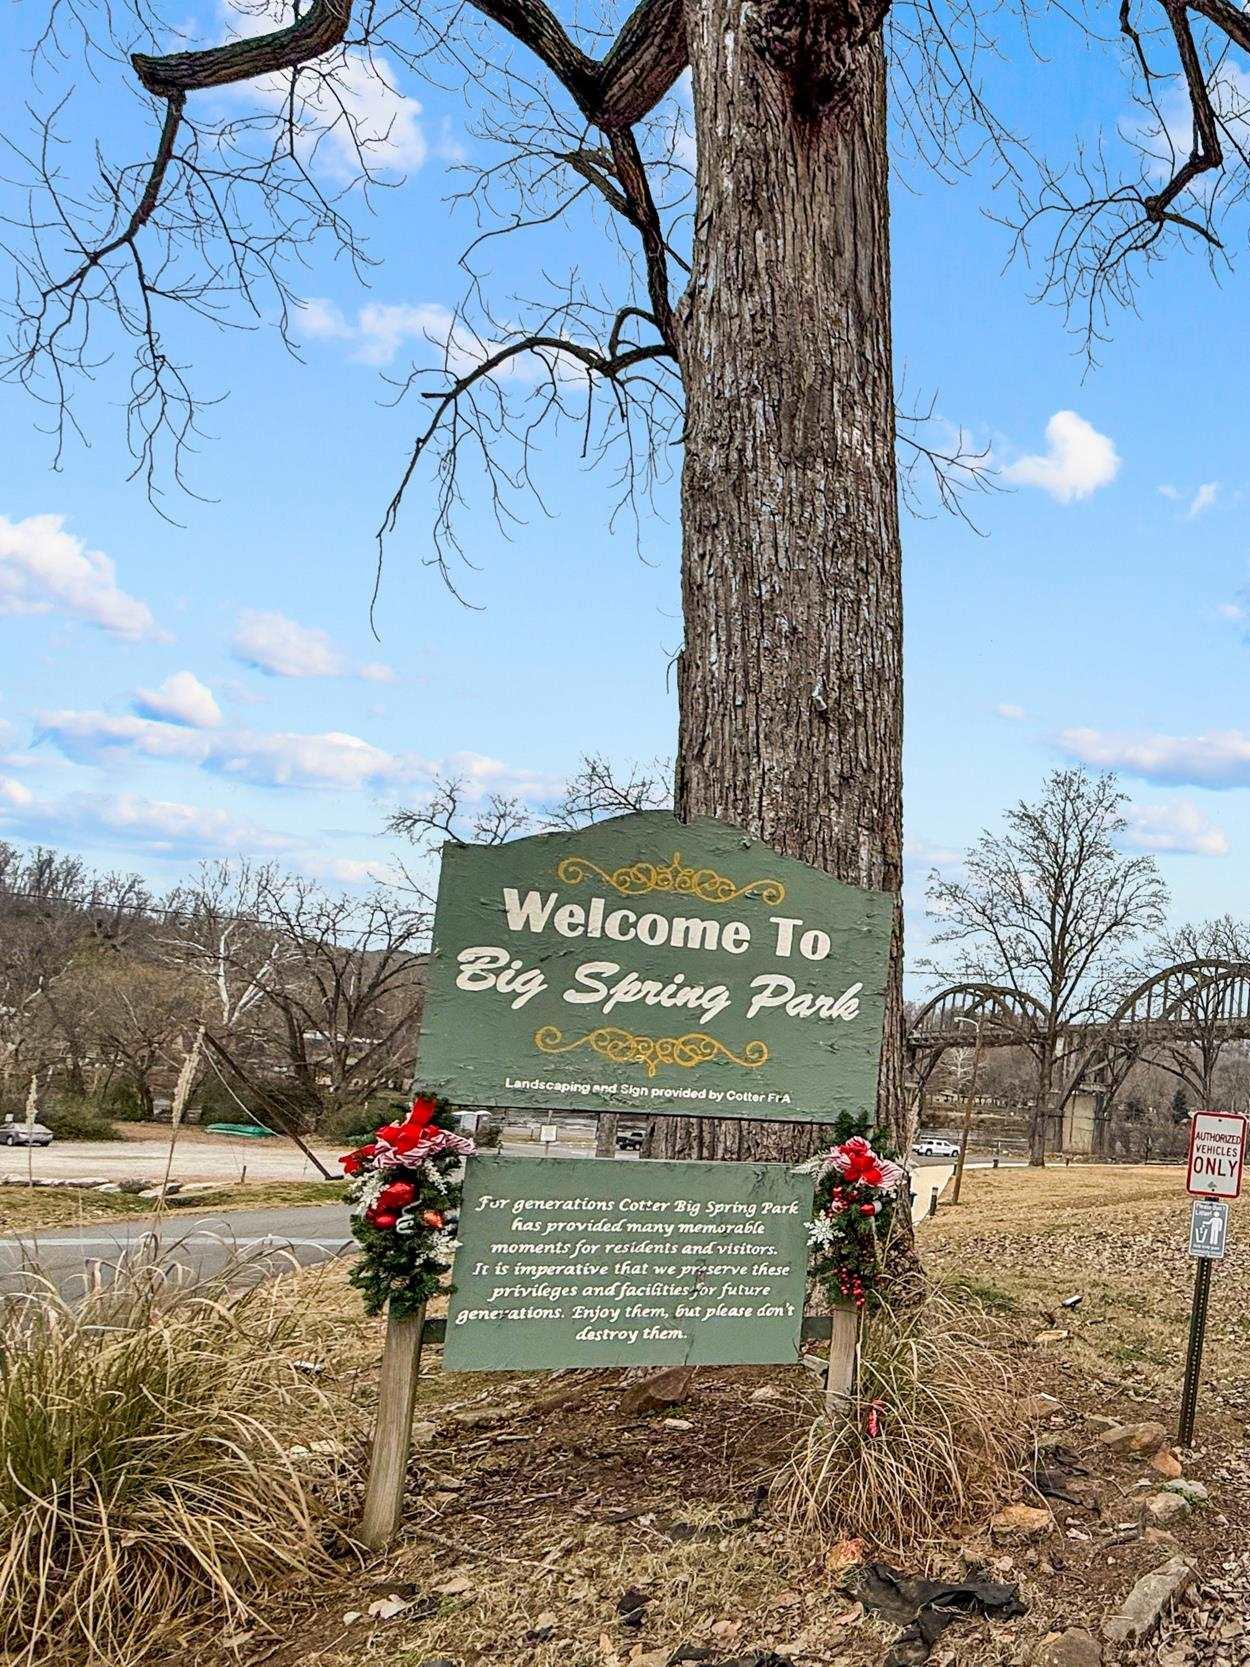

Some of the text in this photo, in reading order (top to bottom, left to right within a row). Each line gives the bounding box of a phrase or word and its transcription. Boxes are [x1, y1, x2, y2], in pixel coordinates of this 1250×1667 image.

[503, 887, 831, 961] Welcome To
[455, 946, 863, 1024] Big Spring Park
[505, 1077, 591, 1095] Landscaping
[592, 1083, 618, 1094] and
[620, 1084, 649, 1097] Sign
[651, 1087, 707, 1099] provided
[708, 1090, 724, 1102] by
[726, 1090, 765, 1102] Cotter
[1195, 1131, 1241, 1145] AUTHORIZED
[1196, 1144, 1238, 1157] VEHICLES
[1193, 1156, 1238, 1178] ONLY
[475, 1195, 799, 1217] For generations Cotter Big Spring Park
[511, 1217, 765, 1237] has provided many memorable
[490, 1239, 778, 1259] moments for residents and visitors.
[472, 1261, 791, 1279] It is imperative that we preserve these
[486, 1282, 771, 1301] privileges and facilities for future
[455, 1302, 795, 1325] generations. Enjoy them, but please don't
[576, 1325, 688, 1344] destroy them.
